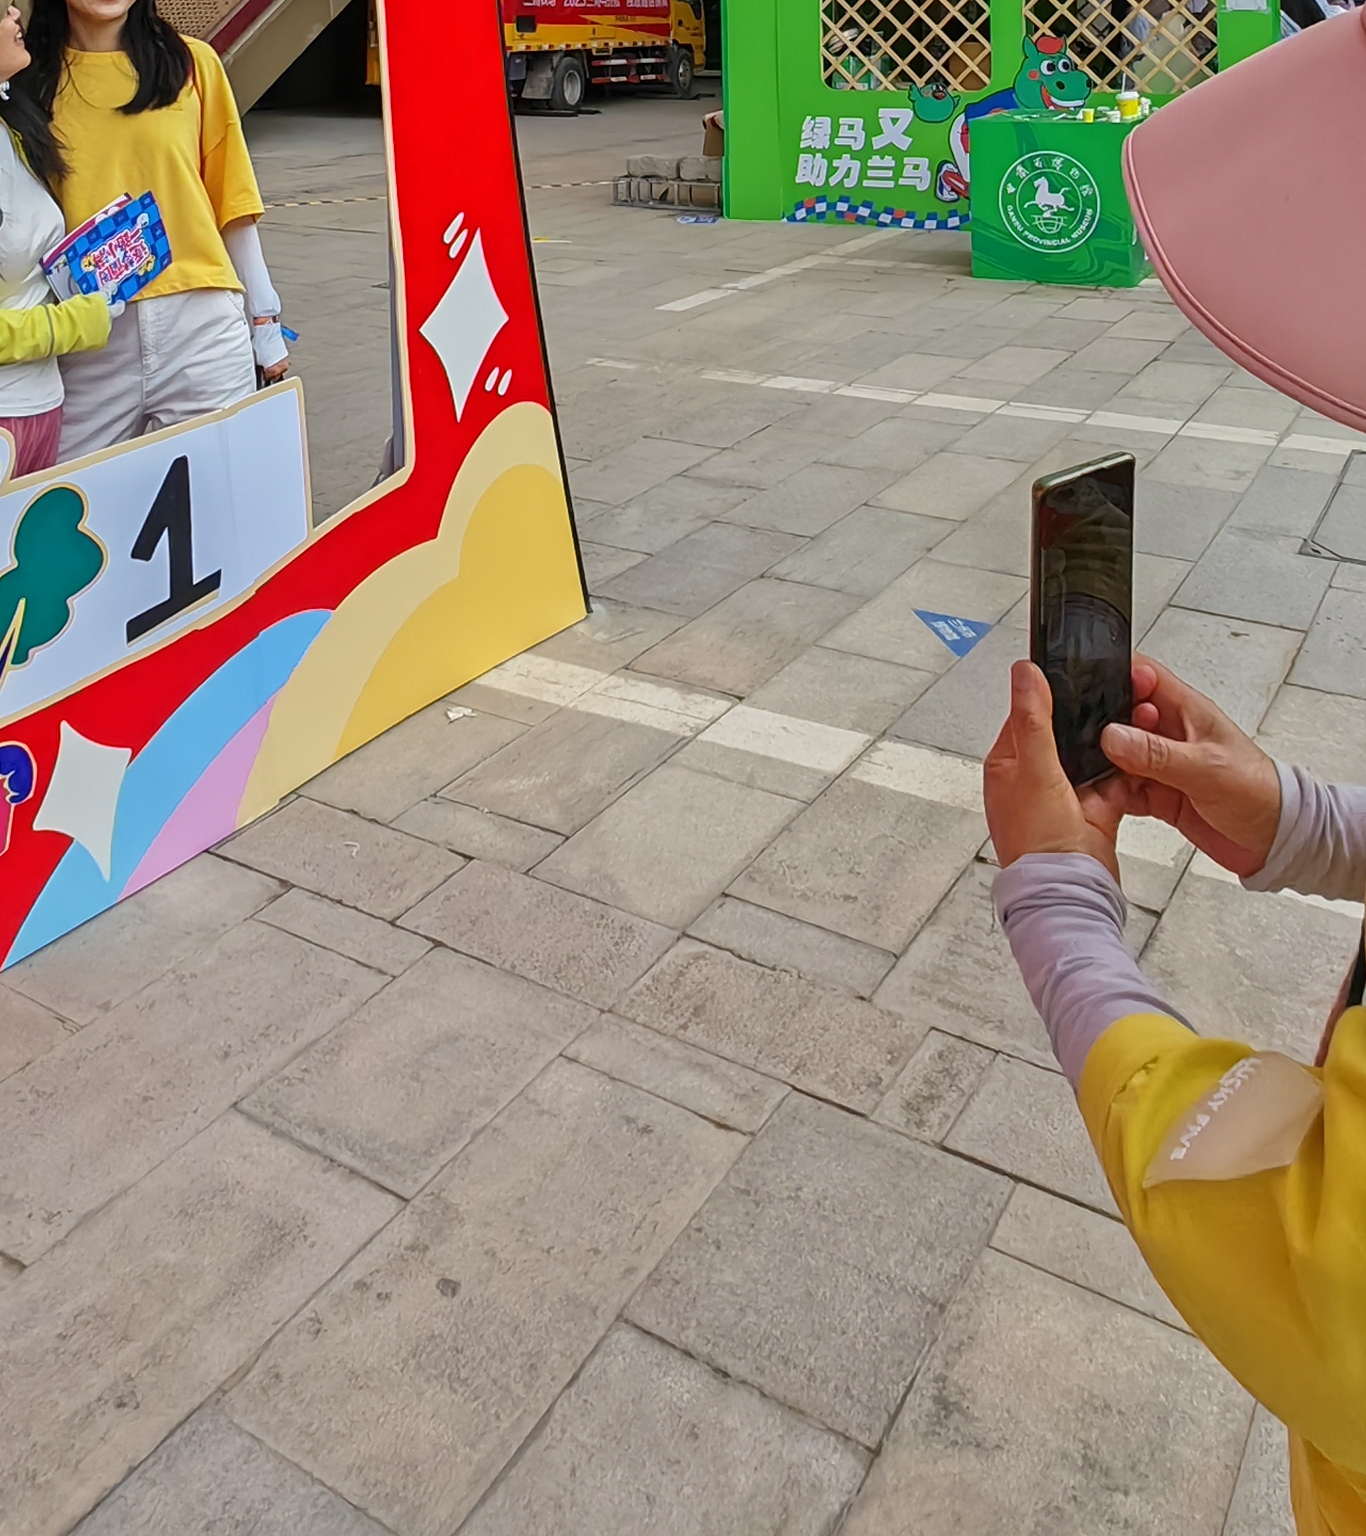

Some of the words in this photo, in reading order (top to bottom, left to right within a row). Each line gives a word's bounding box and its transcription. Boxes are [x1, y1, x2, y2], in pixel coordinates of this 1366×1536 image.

[799, 107, 914, 151] 绿马又
[795, 152, 932, 192] 助力兰马
[125, 455, 222, 645] 1
